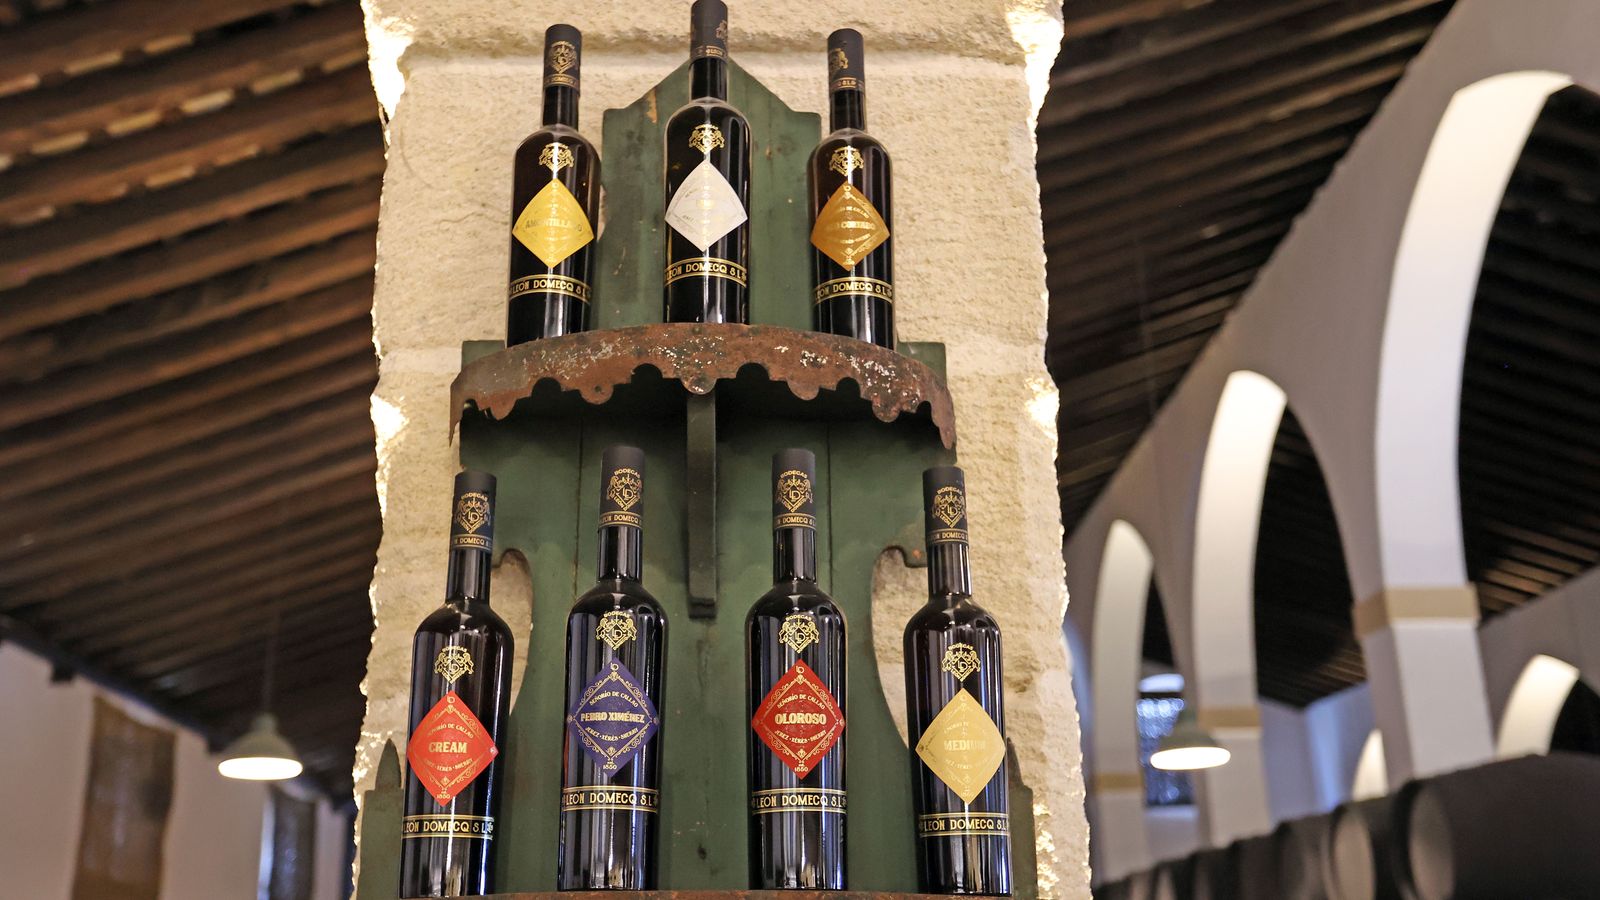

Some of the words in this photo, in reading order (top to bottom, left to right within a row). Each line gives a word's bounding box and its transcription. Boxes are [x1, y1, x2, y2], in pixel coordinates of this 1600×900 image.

[685, 262, 728, 274] DOMECQ
[533, 279, 574, 292] DOMECQ
[832, 282, 873, 293] DOMECQ
[581, 711, 608, 722] PEDRO
[775, 712, 827, 725] OLOROSO
[429, 741, 468, 754] CREAM
[589, 792, 637, 805] DOMECQ
[781, 794, 829, 806] DOMECQ
[423, 820, 470, 833] DOMECQ
[949, 818, 995, 830] DOMECQ
